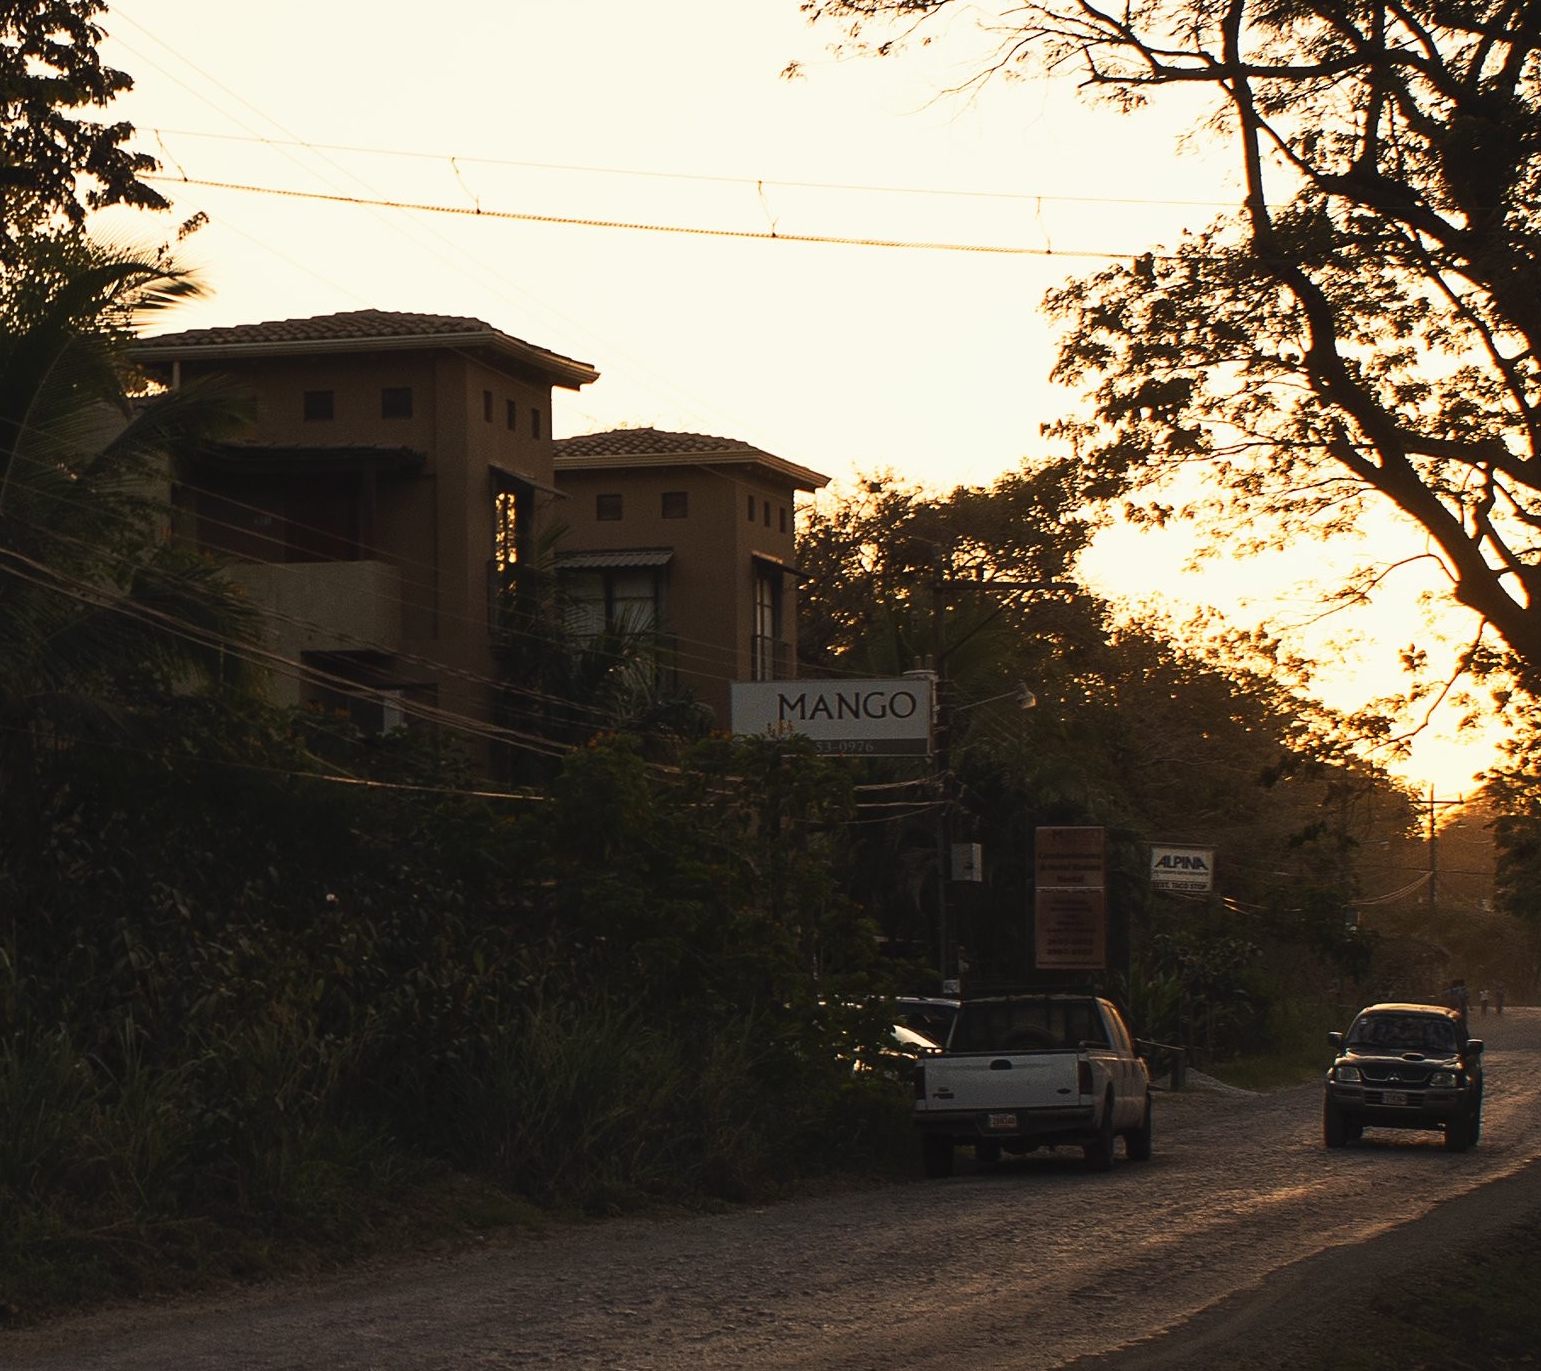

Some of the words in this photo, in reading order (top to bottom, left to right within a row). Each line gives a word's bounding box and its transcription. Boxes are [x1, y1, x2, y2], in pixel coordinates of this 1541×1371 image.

[777, 691, 917, 720] MANGO
[815, 740, 874, 754] 53-0976
[1154, 855, 1209, 871] ALPINA
